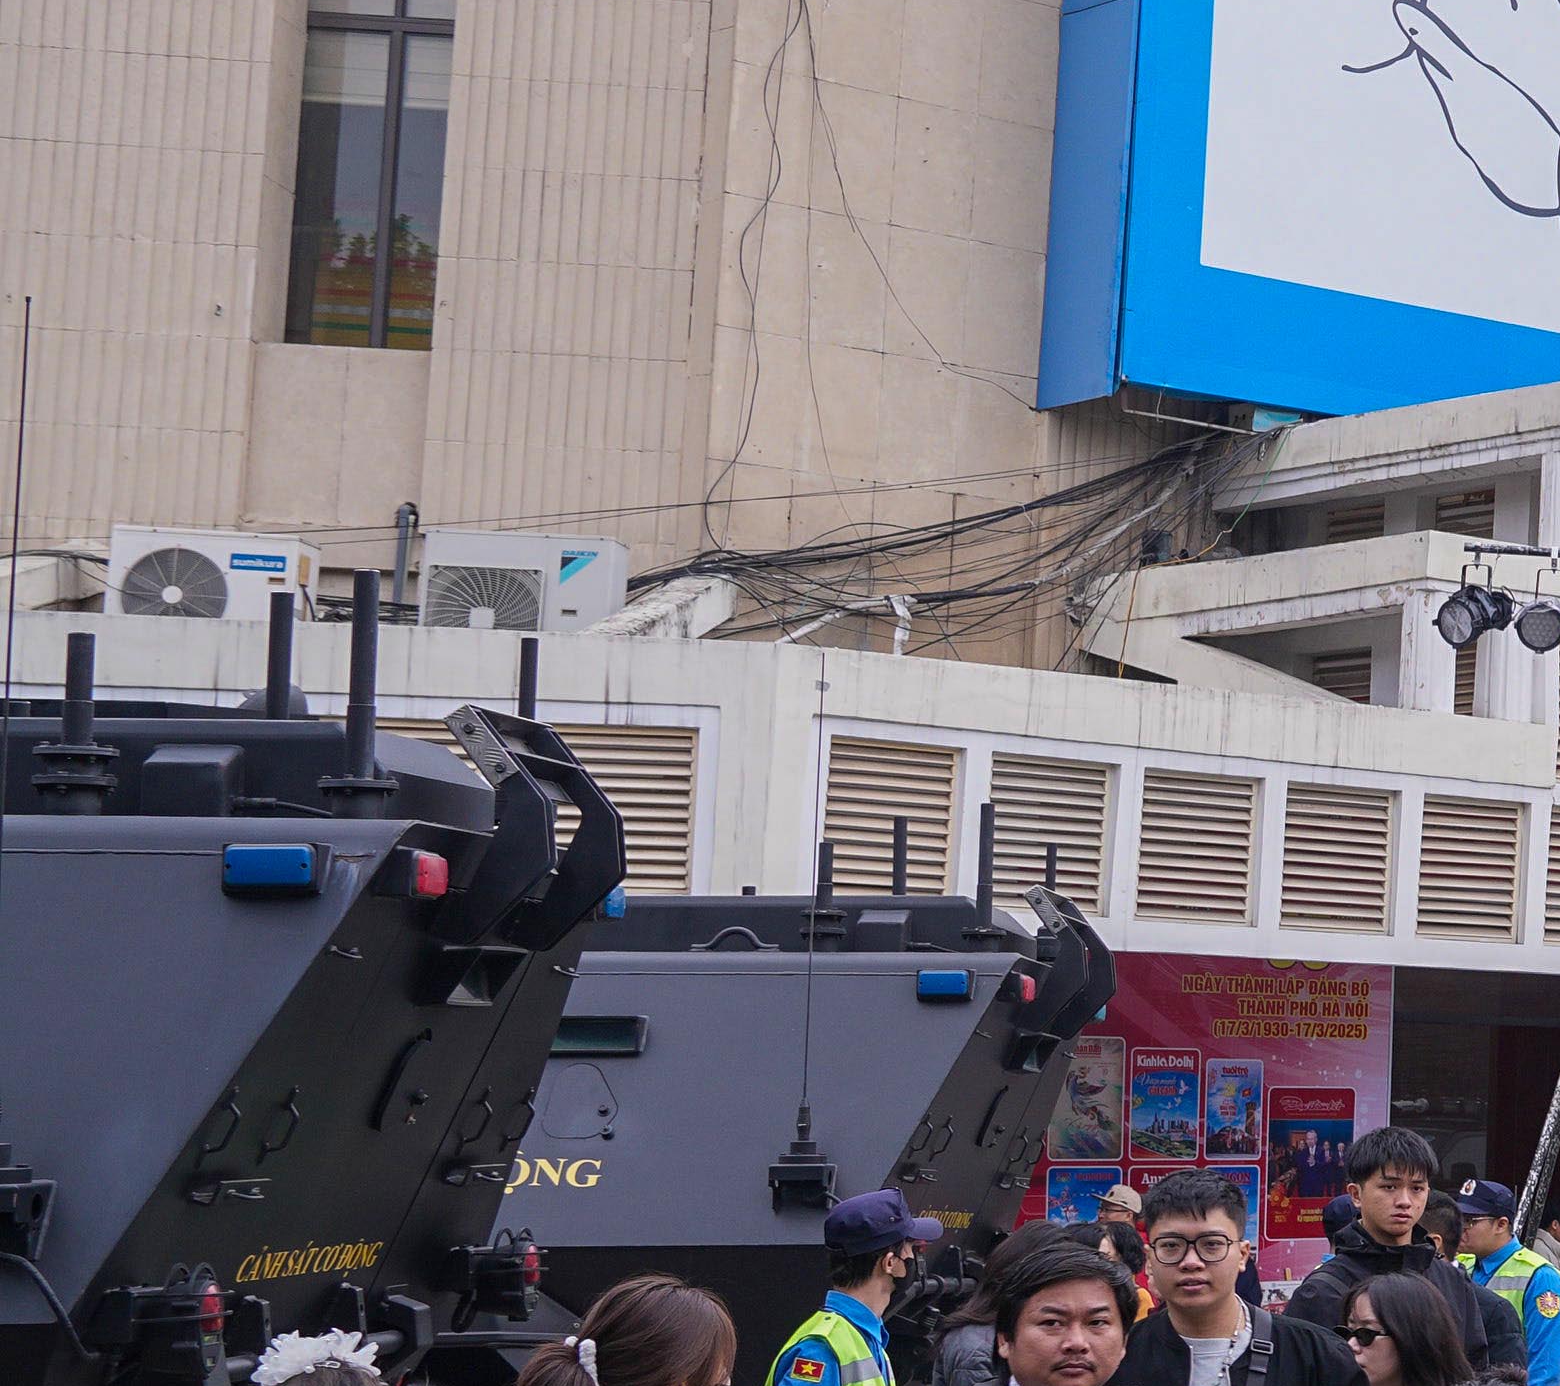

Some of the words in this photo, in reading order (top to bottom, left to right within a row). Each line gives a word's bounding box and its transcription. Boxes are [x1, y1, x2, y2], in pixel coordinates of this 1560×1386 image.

[561, 549, 600, 558] DAIKIN
[1182, 974, 1223, 994] NGÀY
[1226, 975, 1274, 995] THÀNH
[1277, 976, 1304, 998] LẬP
[1308, 975, 1348, 998] ĐẢNG
[1351, 978, 1371, 1001] BỘ
[1238, 998, 1286, 1017] THÀNH
[1289, 996, 1319, 1018] PHỐ
[1322, 998, 1342, 1018] HÀ
[1344, 1000, 1369, 1022] NỘI
[1212, 1019, 1368, 1040] (17/3/1930-17/3/2025)
[506, 1150, 603, 1195] ỘNG
[235, 1246, 286, 1283] CẢNH
[284, 1240, 315, 1277] SÁT
[335, 1238, 385, 1278] ĐỘNG
